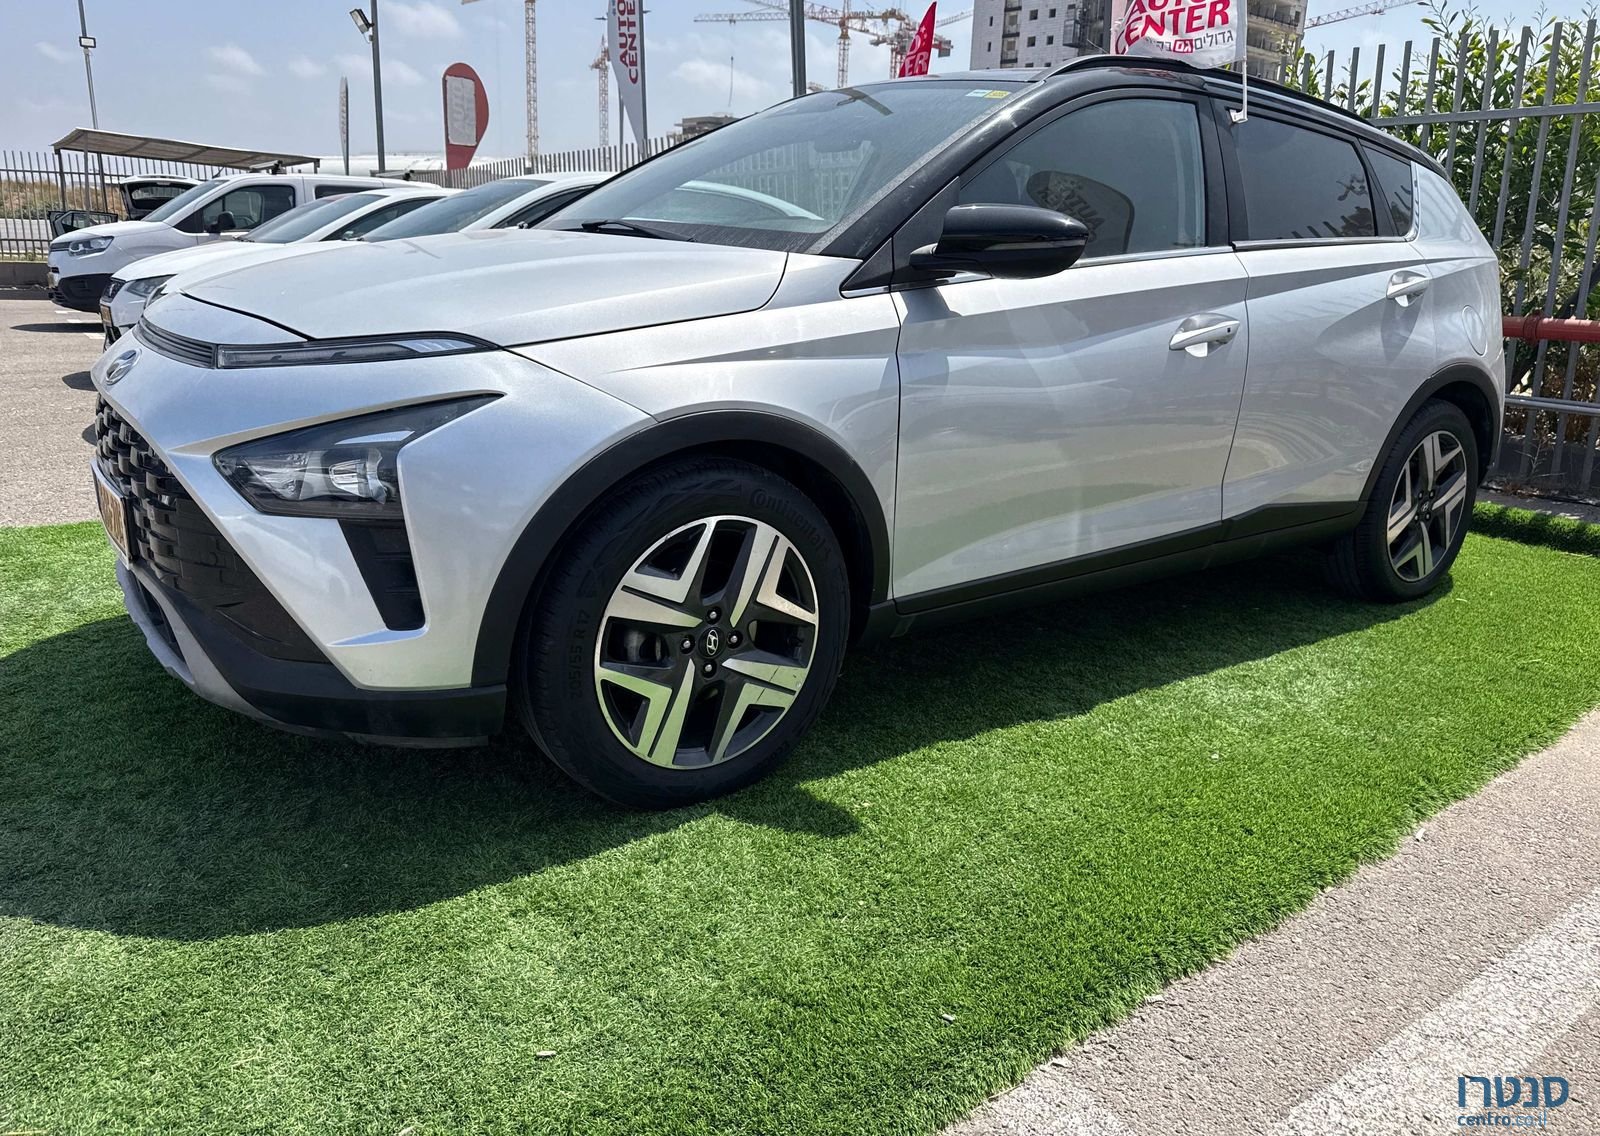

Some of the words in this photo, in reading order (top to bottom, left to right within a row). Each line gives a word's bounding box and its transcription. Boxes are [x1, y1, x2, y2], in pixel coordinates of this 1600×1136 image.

[617, 0, 629, 68] AUTO
[1115, 0, 1231, 55] CENTER
[1194, 30, 1234, 50] גדולים
